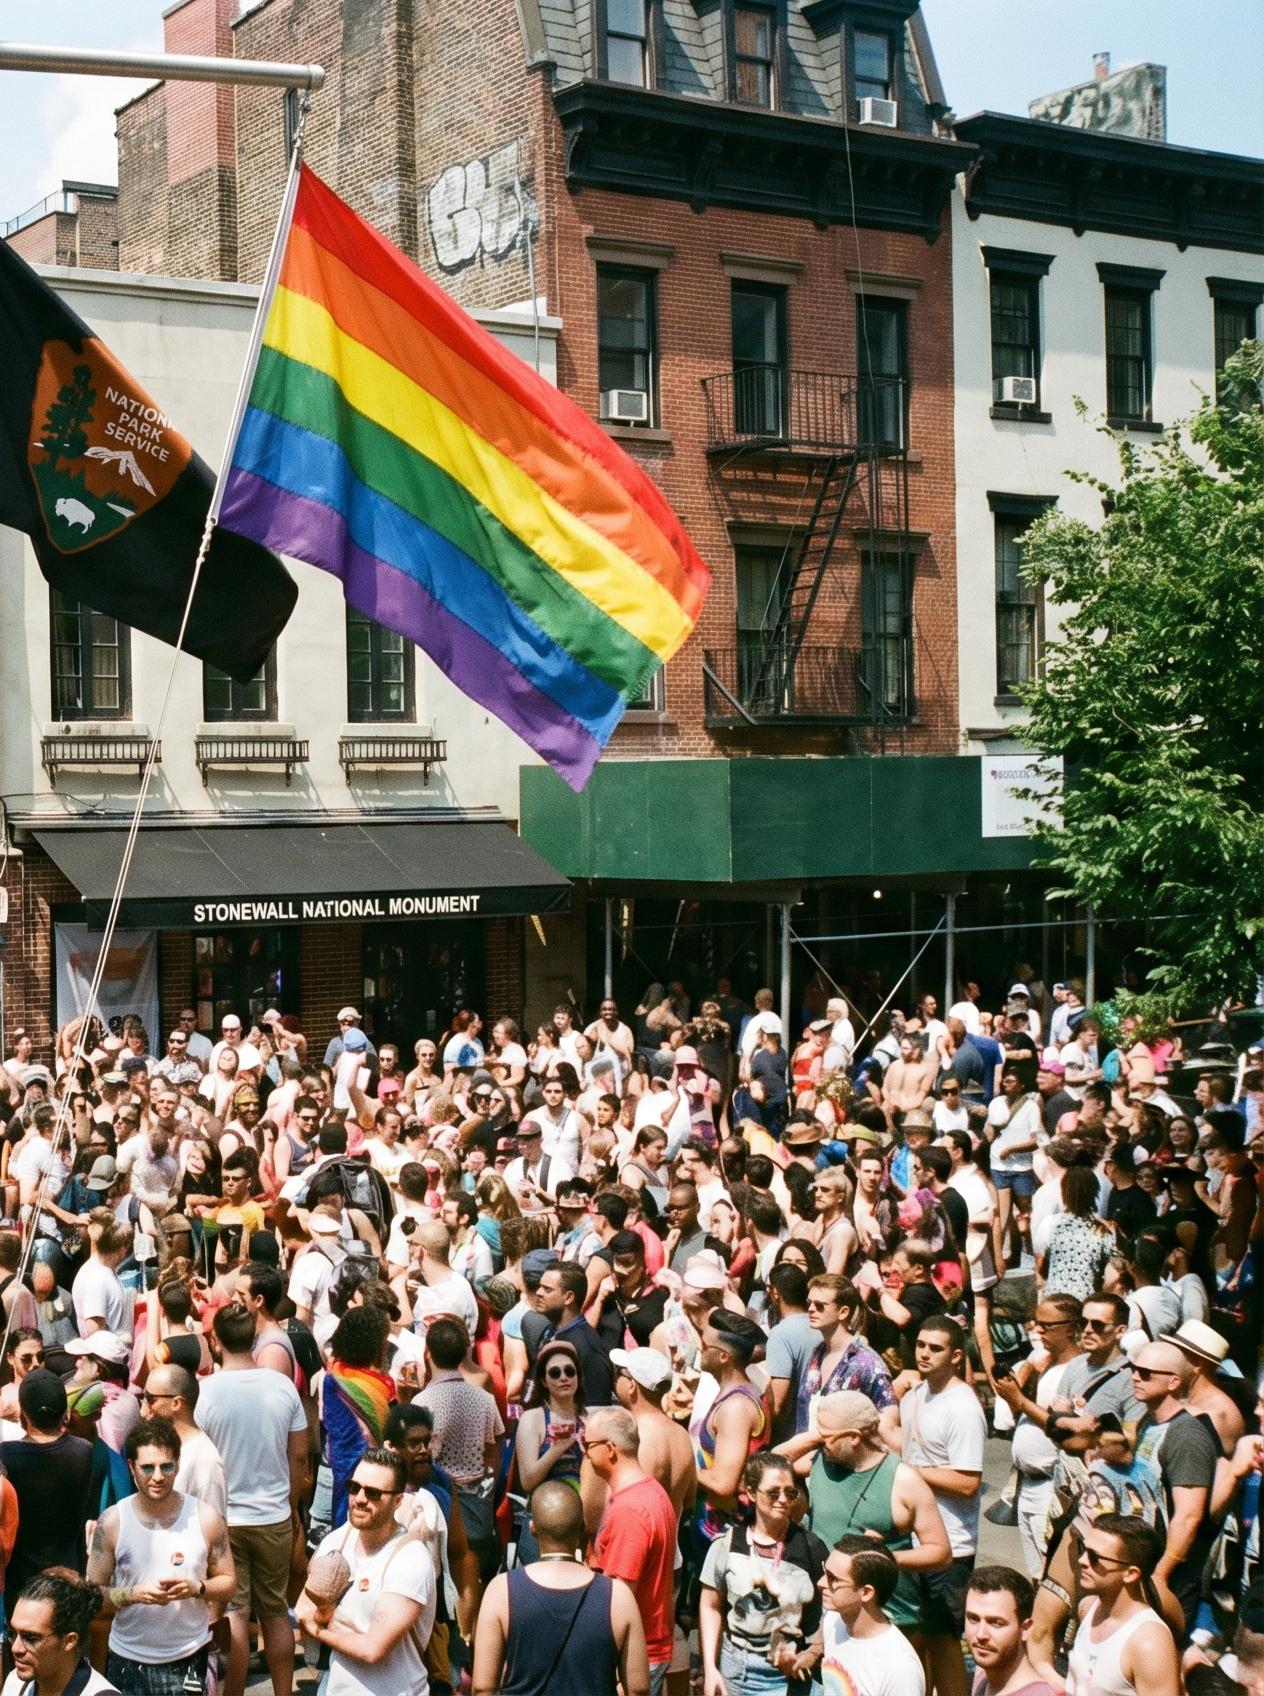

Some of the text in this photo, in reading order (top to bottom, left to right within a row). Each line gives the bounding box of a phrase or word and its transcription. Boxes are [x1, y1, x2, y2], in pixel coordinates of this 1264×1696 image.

[105, 387, 172, 430] NATION
[105, 422, 169, 462] SERVICE
[119, 413, 163, 442] PARK
[194, 895, 481, 922] STONEWALL NATIONAL MONUMENT
